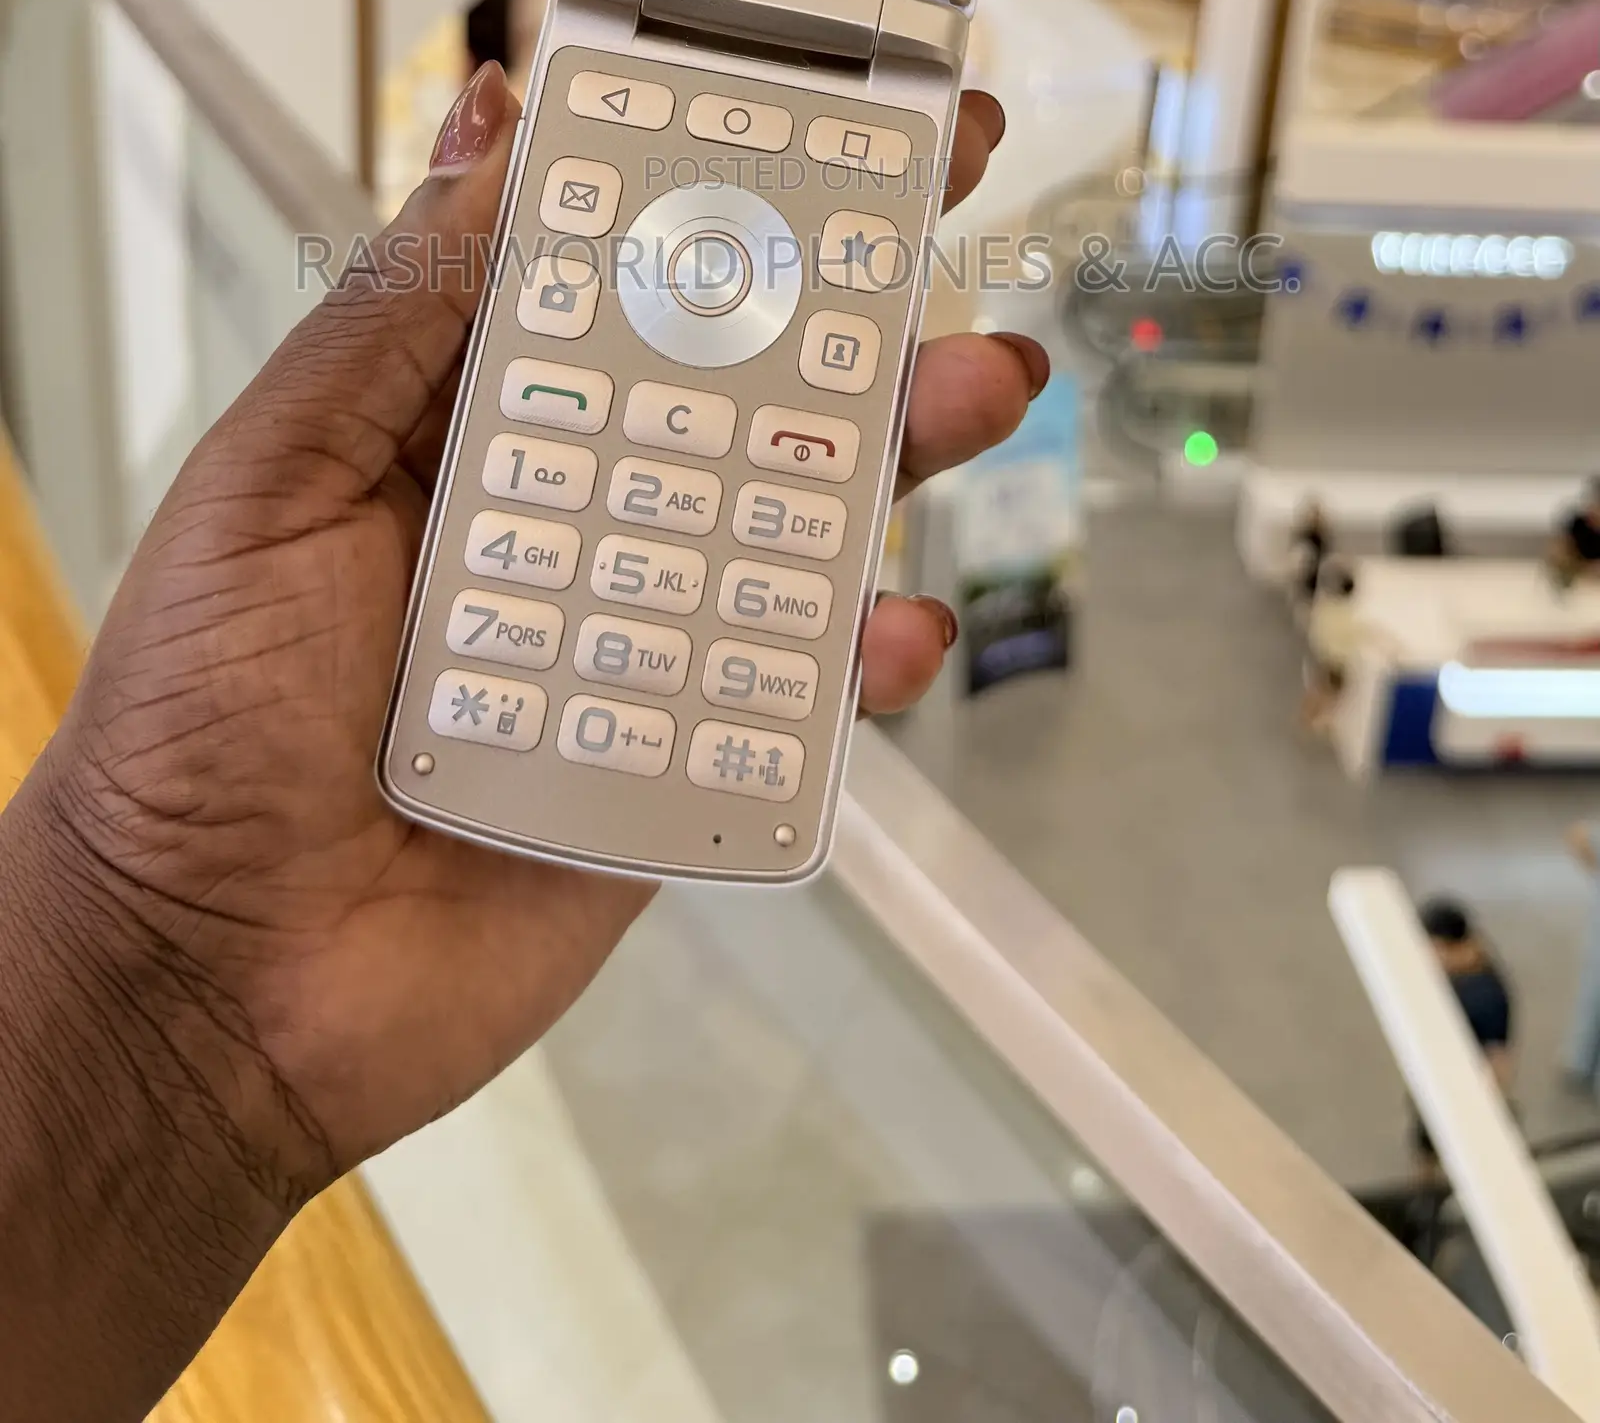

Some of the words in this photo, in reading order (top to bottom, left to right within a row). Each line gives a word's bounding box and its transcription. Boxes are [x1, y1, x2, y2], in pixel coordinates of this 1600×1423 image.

[666, 404, 692, 435] C
[511, 448, 525, 489] 1
[624, 472, 662, 516] 2
[666, 491, 706, 515] ABC
[748, 495, 787, 538] 3
[791, 515, 832, 538] DEF
[481, 530, 517, 570] 4
[525, 546, 559, 569] GHI
[609, 551, 649, 594] 5
[654, 572, 688, 593] JKL
[734, 578, 770, 618] 6
[774, 596, 818, 618] MNO
[463, 604, 499, 645] 7
[496, 621, 546, 647] PQRS
[593, 631, 632, 675] 8
[638, 651, 676, 673] TUV
[719, 656, 757, 698] 9
[759, 674, 808, 699] WXYZ
